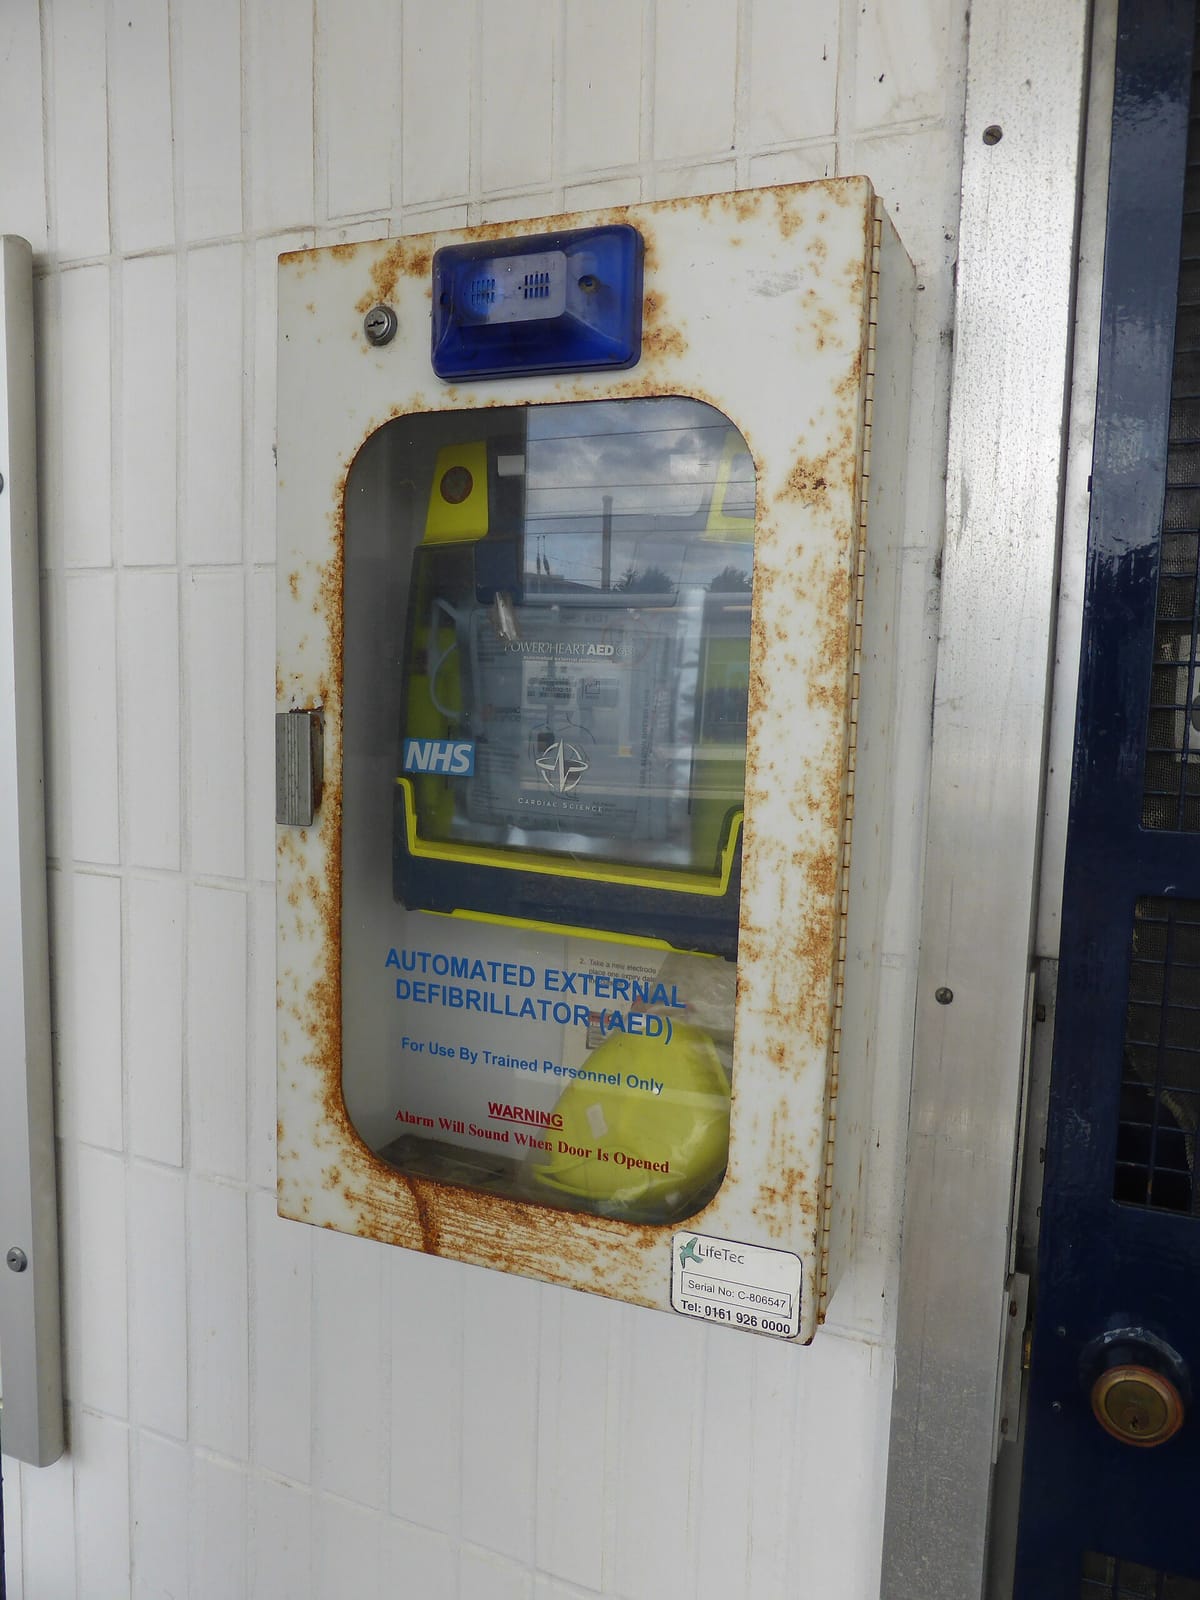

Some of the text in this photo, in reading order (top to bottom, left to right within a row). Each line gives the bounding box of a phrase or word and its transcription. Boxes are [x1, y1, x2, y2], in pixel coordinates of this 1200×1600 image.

[587, 644, 614, 656] AED
[405, 740, 473, 774] NHS
[517, 797, 559, 809] CARDIAC
[562, 801, 603, 813] SCIENCE
[385, 948, 687, 1009] AUTOMATED EXTERNAL
[396, 979, 590, 1028] DEFIBRILLATOR
[599, 1008, 673, 1045] (AED)
[402, 1037, 664, 1096] For Use By Trained Personnel Only
[488, 1102, 564, 1129] WARNING
[395, 1110, 670, 1174] Alarm Will Sound When Door Is Opened
[698, 1243, 745, 1265] LifeTec
[688, 1280, 786, 1309] Serial No: C-806547
[681, 1299, 791, 1335] Tel: 0161 926 0000
